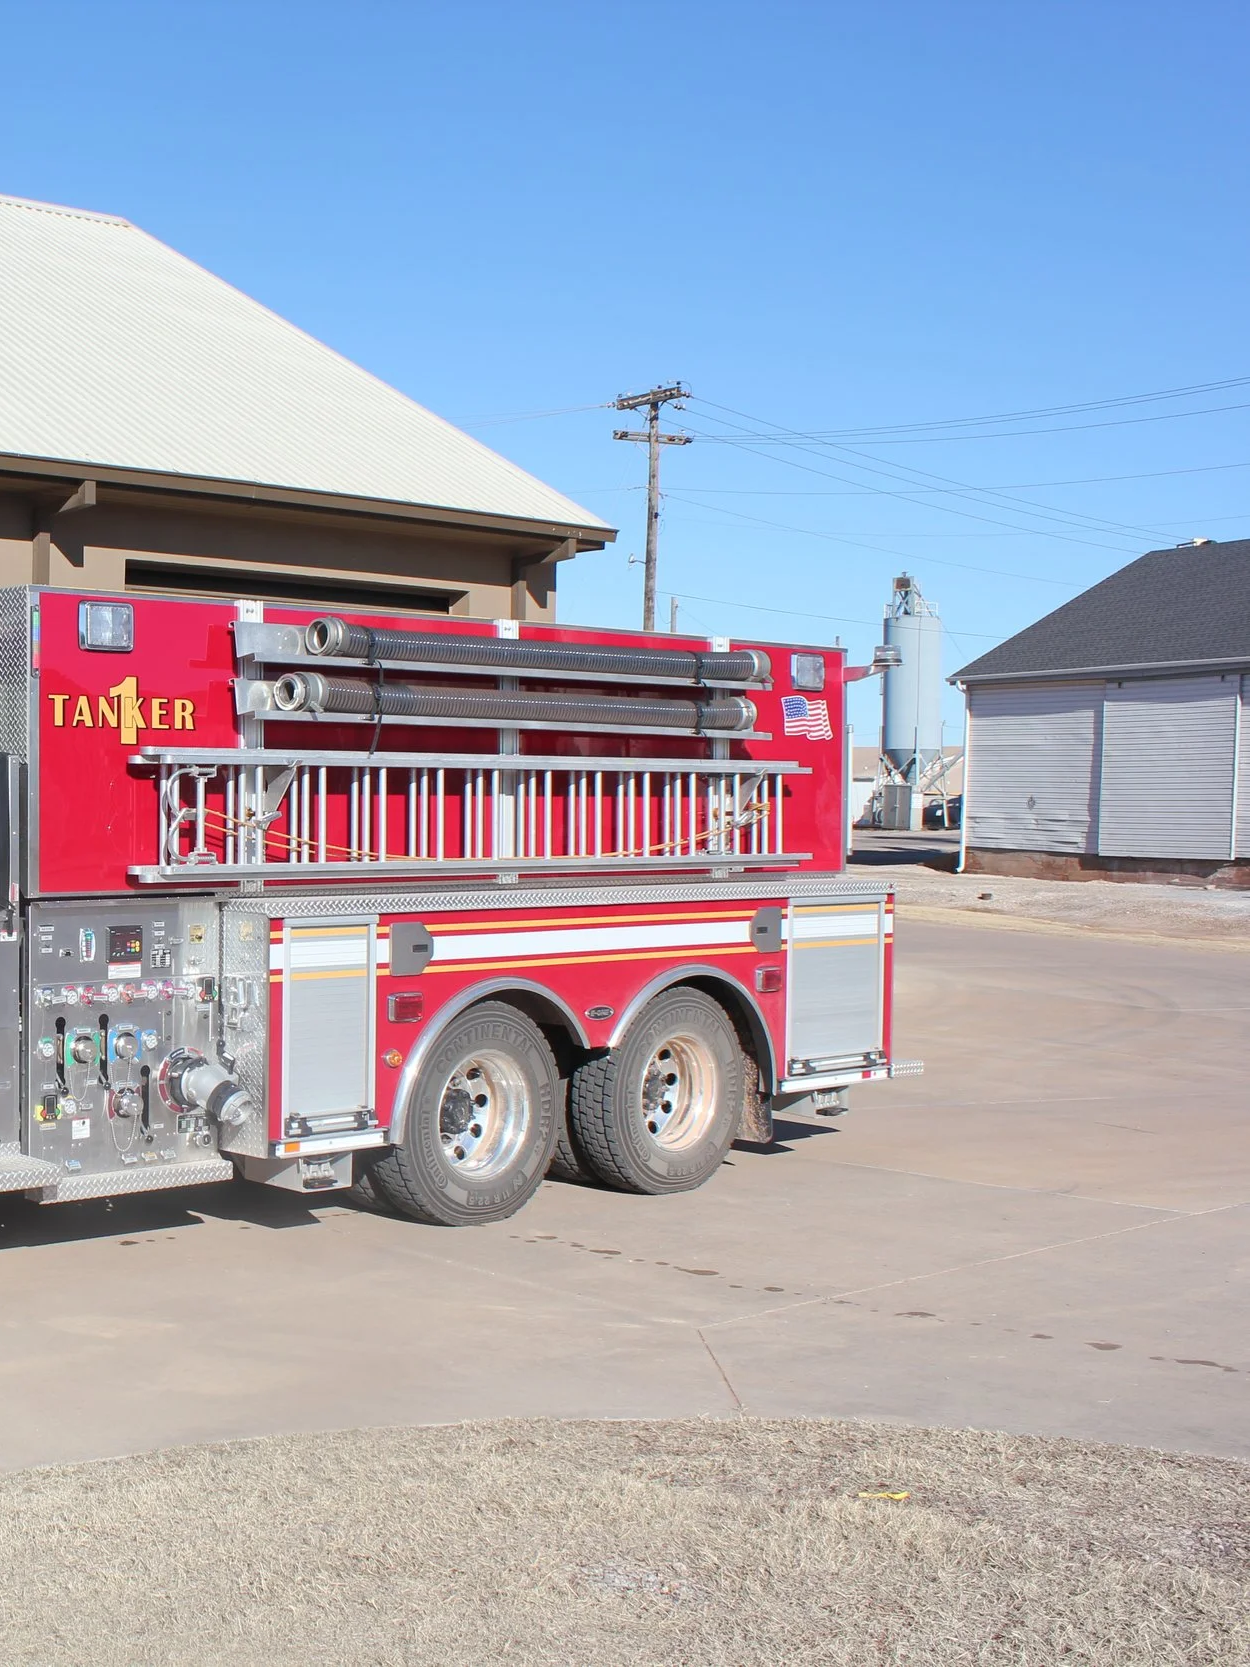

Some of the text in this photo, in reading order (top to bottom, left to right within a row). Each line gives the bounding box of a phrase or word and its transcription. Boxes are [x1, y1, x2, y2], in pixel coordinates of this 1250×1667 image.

[48, 676, 195, 745] TANKER 1
[436, 1023, 534, 1075] CONTINENTAL
[639, 1007, 720, 1056] CONTINENTAL
[421, 1110, 449, 1189] Continental
